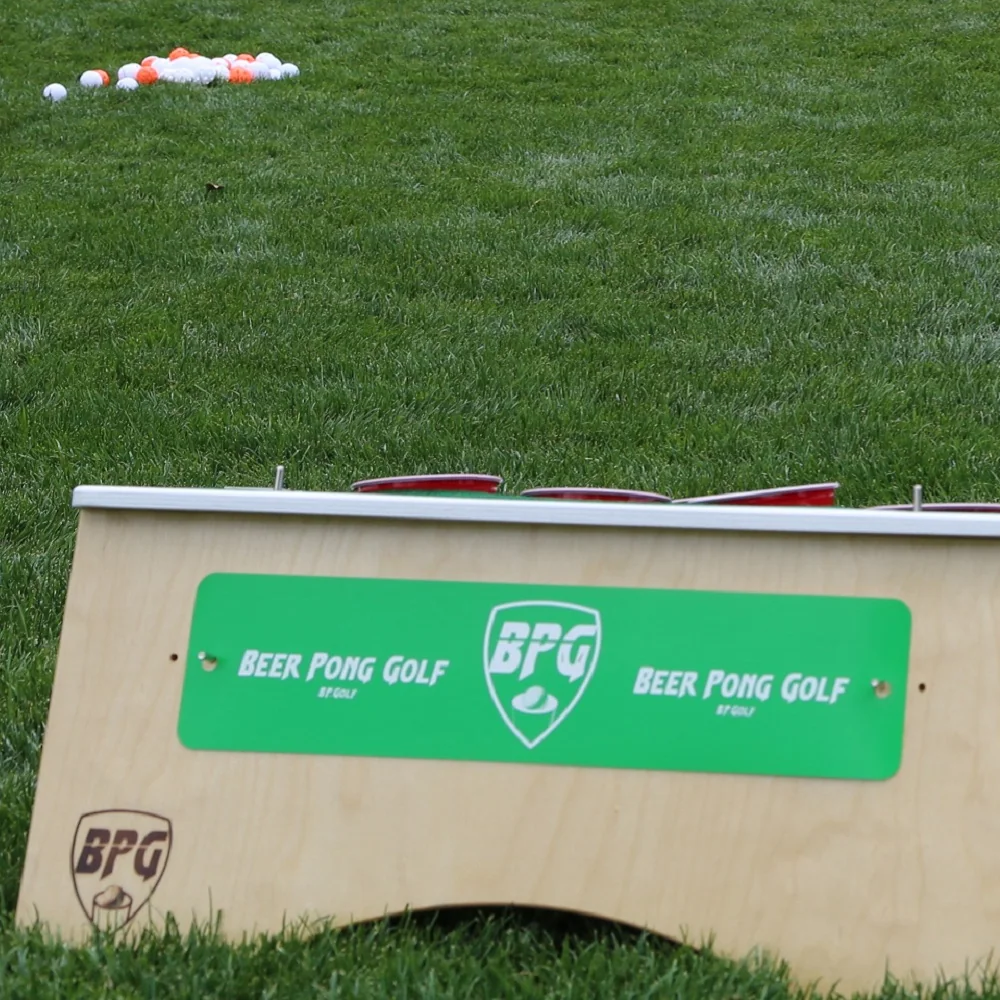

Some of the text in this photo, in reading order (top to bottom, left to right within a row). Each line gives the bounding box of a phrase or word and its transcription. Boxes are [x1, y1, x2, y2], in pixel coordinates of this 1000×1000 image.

[237, 649, 450, 686] BEER PONG GOLF
[488, 621, 597, 683] BPG
[633, 666, 850, 704] BEER PONG GOLF
[75, 828, 168, 882] BPG
